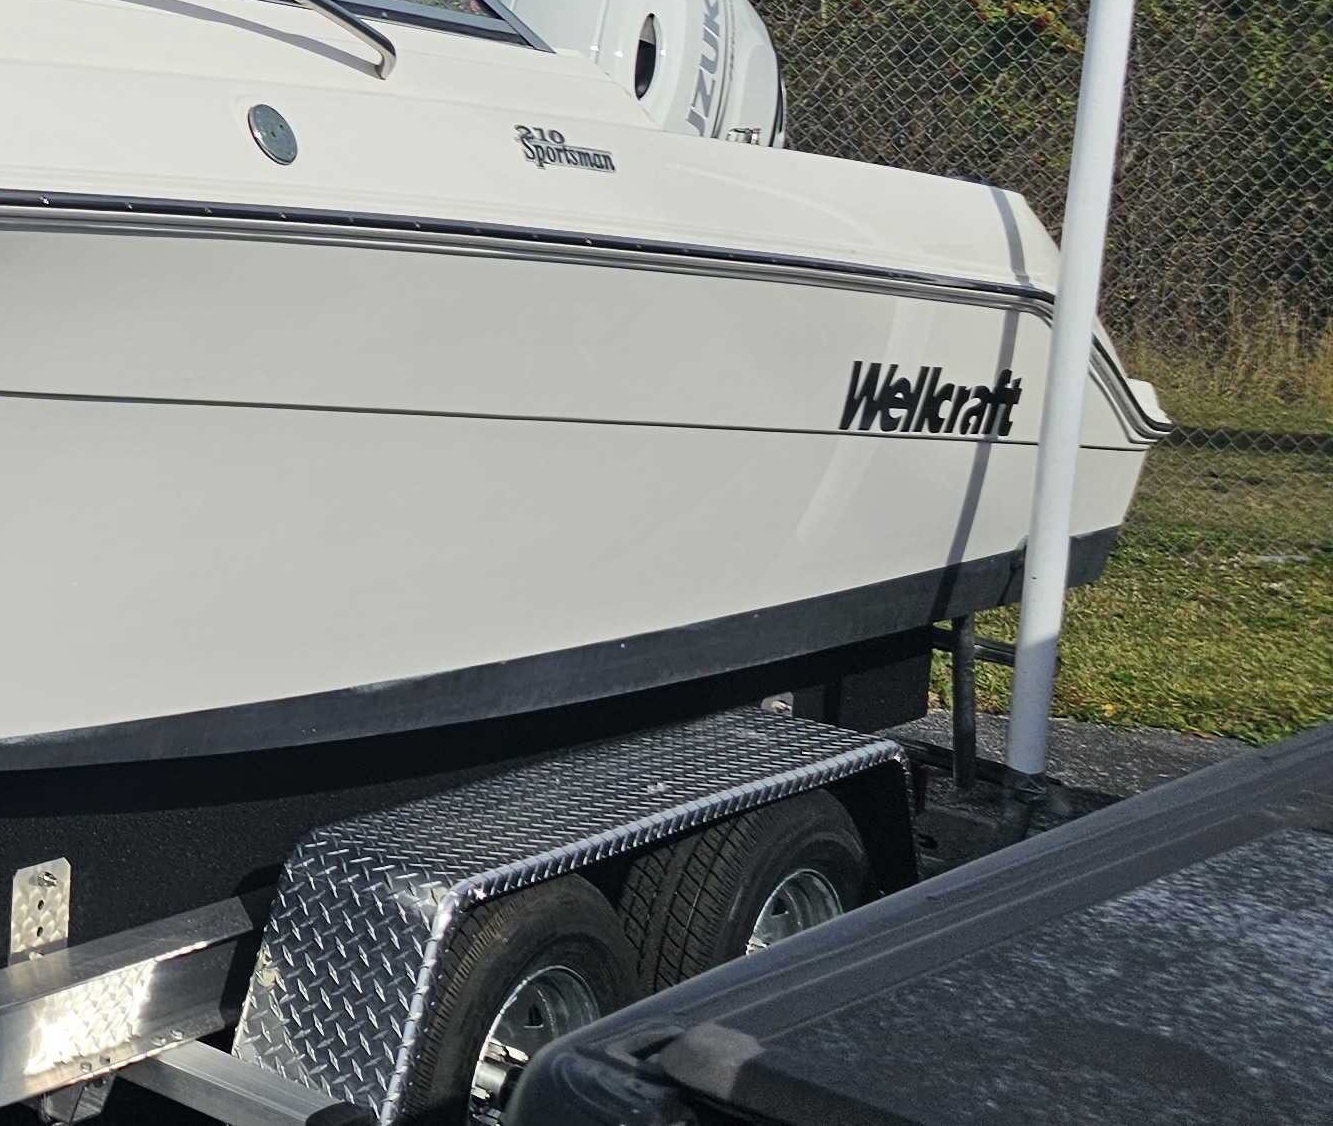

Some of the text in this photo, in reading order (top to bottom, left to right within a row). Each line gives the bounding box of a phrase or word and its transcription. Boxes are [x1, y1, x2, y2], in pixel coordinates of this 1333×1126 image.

[514, 125, 565, 144] 210
[521, 136, 616, 171] Sportsman
[838, 360, 1023, 437] Wellcraft
